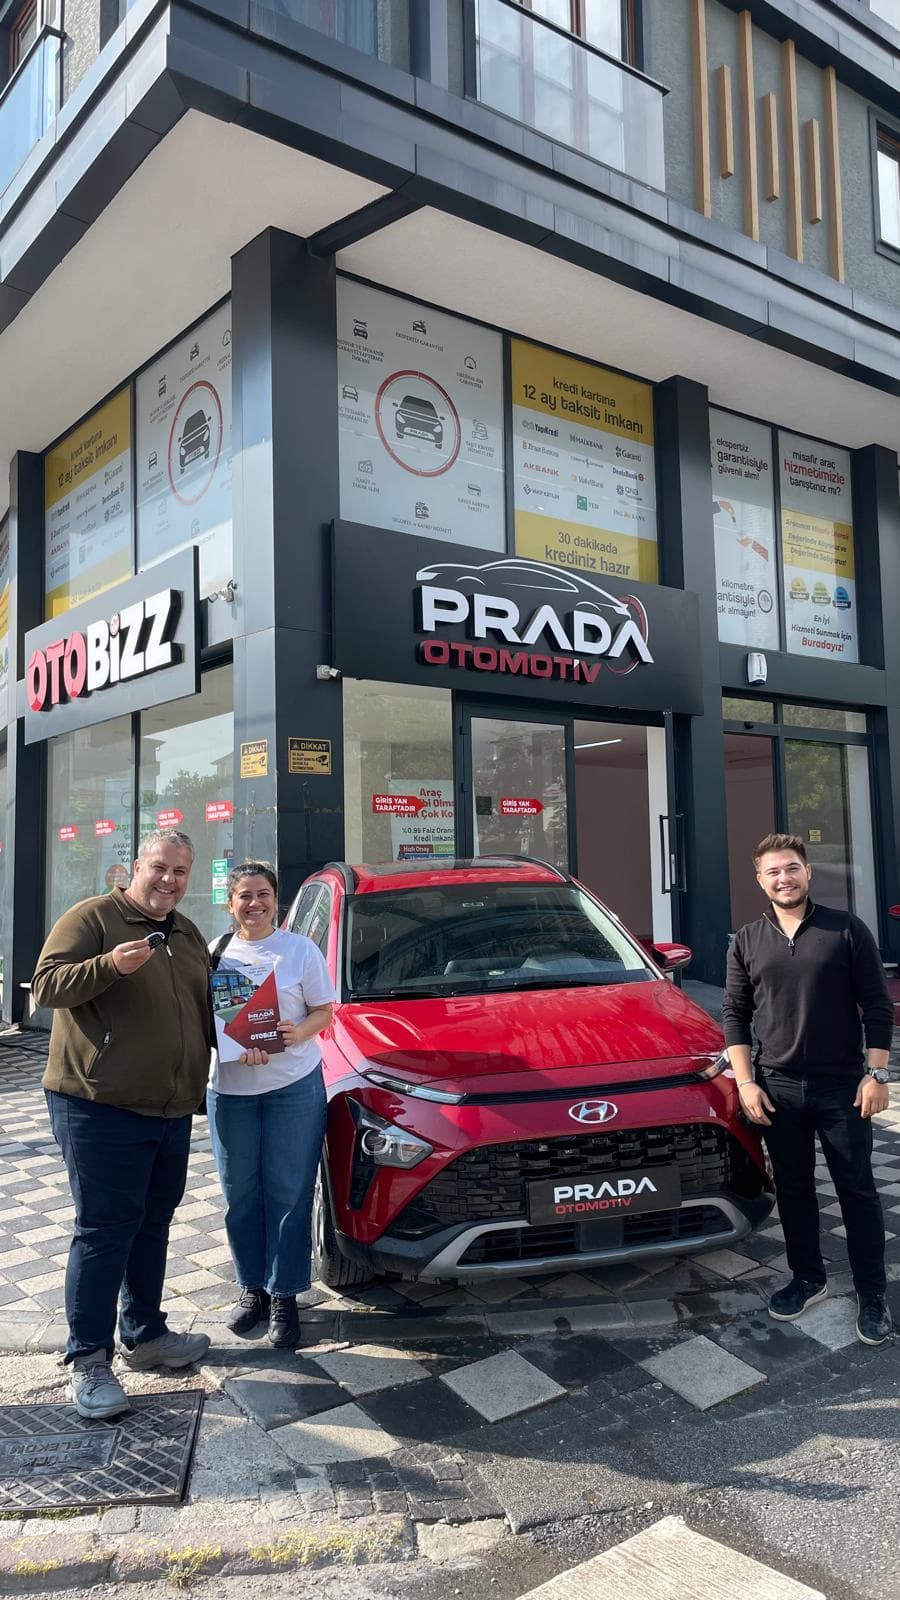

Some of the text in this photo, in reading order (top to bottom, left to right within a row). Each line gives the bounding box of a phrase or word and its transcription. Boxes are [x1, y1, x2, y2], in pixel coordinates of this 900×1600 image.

[553, 377, 616, 408] kredi kartına
[523, 383, 643, 434] 12 ay taksit imkanı
[716, 438, 749, 453] ekspertiz
[717, 451, 768, 472] garantisiyle
[792, 451, 836, 469] misafir araç
[523, 462, 559, 477] AKBANK
[718, 464, 742, 477] güvenli
[784, 459, 845, 485] hizmetimizle
[790, 475, 841, 496] tanıştınız mı?
[558, 531, 618, 555] 30 dakikada
[545, 544, 630, 576] krediniz hazır
[721, 578, 754, 591] kilometre
[422, 585, 654, 663] PRADA
[791, 624, 816, 635] Hizmeti
[816, 628, 841, 639] Sunmak
[802, 637, 844, 652] Buradayız!
[420, 788, 442, 799] Araç
[375, 804, 416, 812] TARAFTADIR
[421, 810, 439, 819] Çok
[554, 1177, 657, 1203] PRADA
